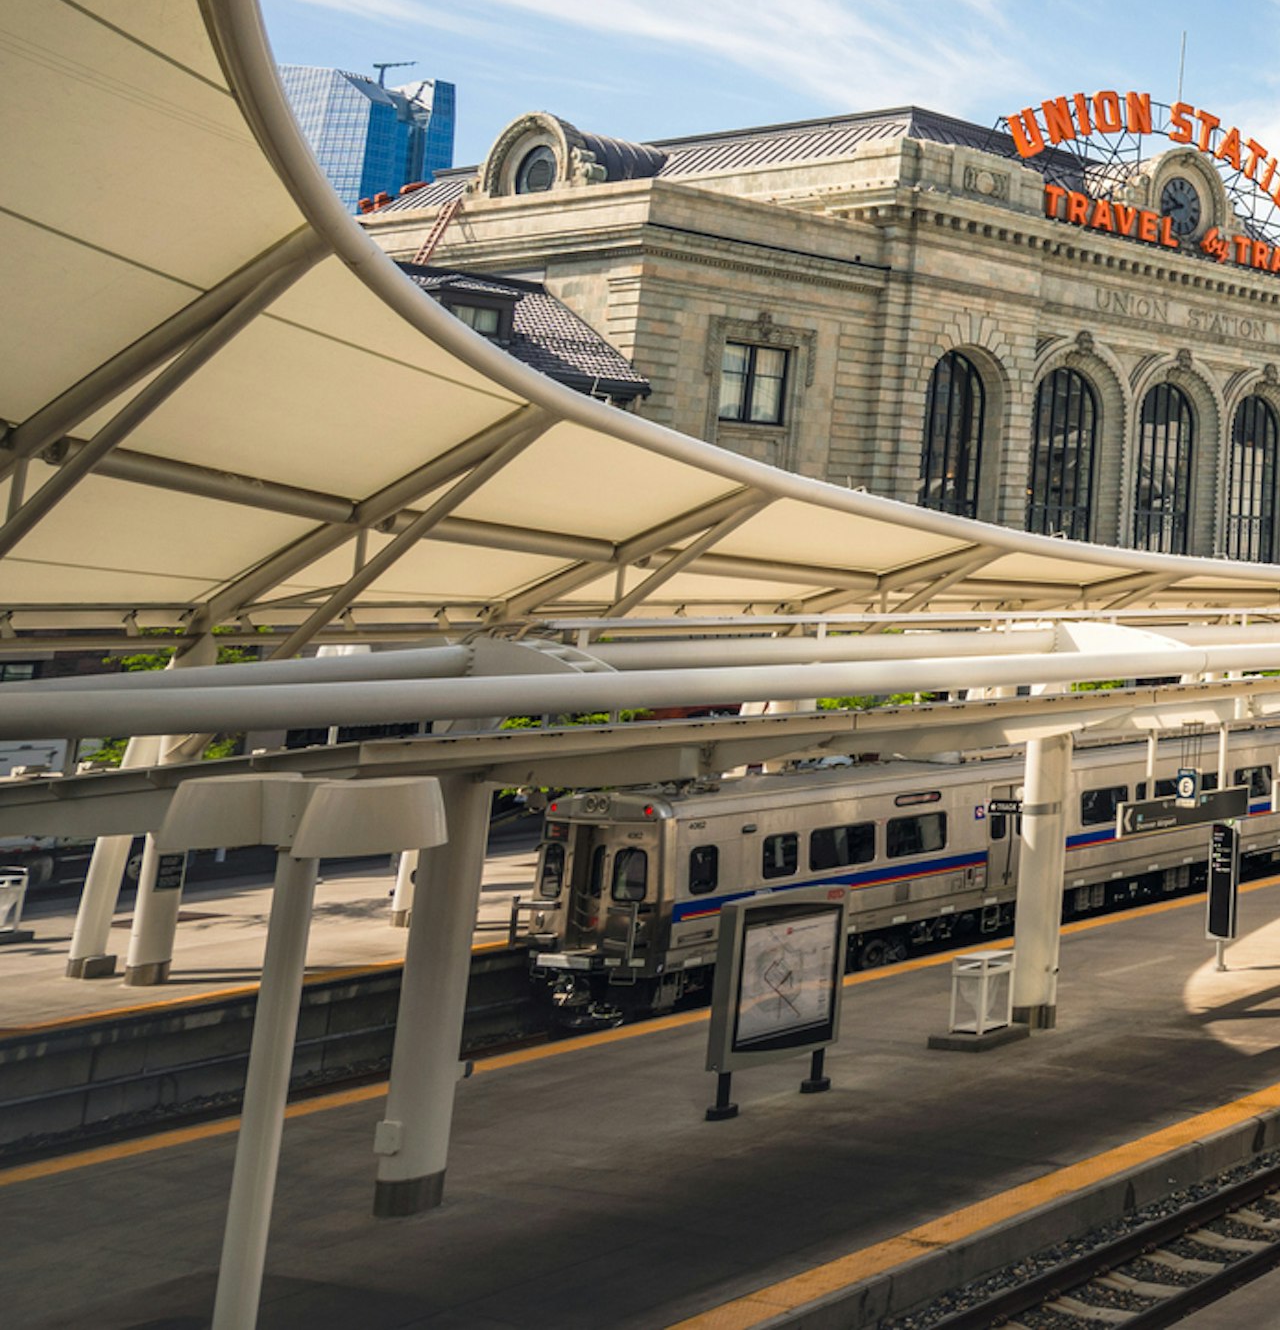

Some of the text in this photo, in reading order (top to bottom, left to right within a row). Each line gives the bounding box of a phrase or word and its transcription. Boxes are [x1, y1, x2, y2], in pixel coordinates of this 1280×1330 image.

[1007, 90, 1152, 158] UNION
[1044, 183, 1179, 248] TRAVEL
[1200, 226, 1231, 264] by
[1095, 288, 1267, 341] UNION STATION
[1182, 781, 1190, 793] E
